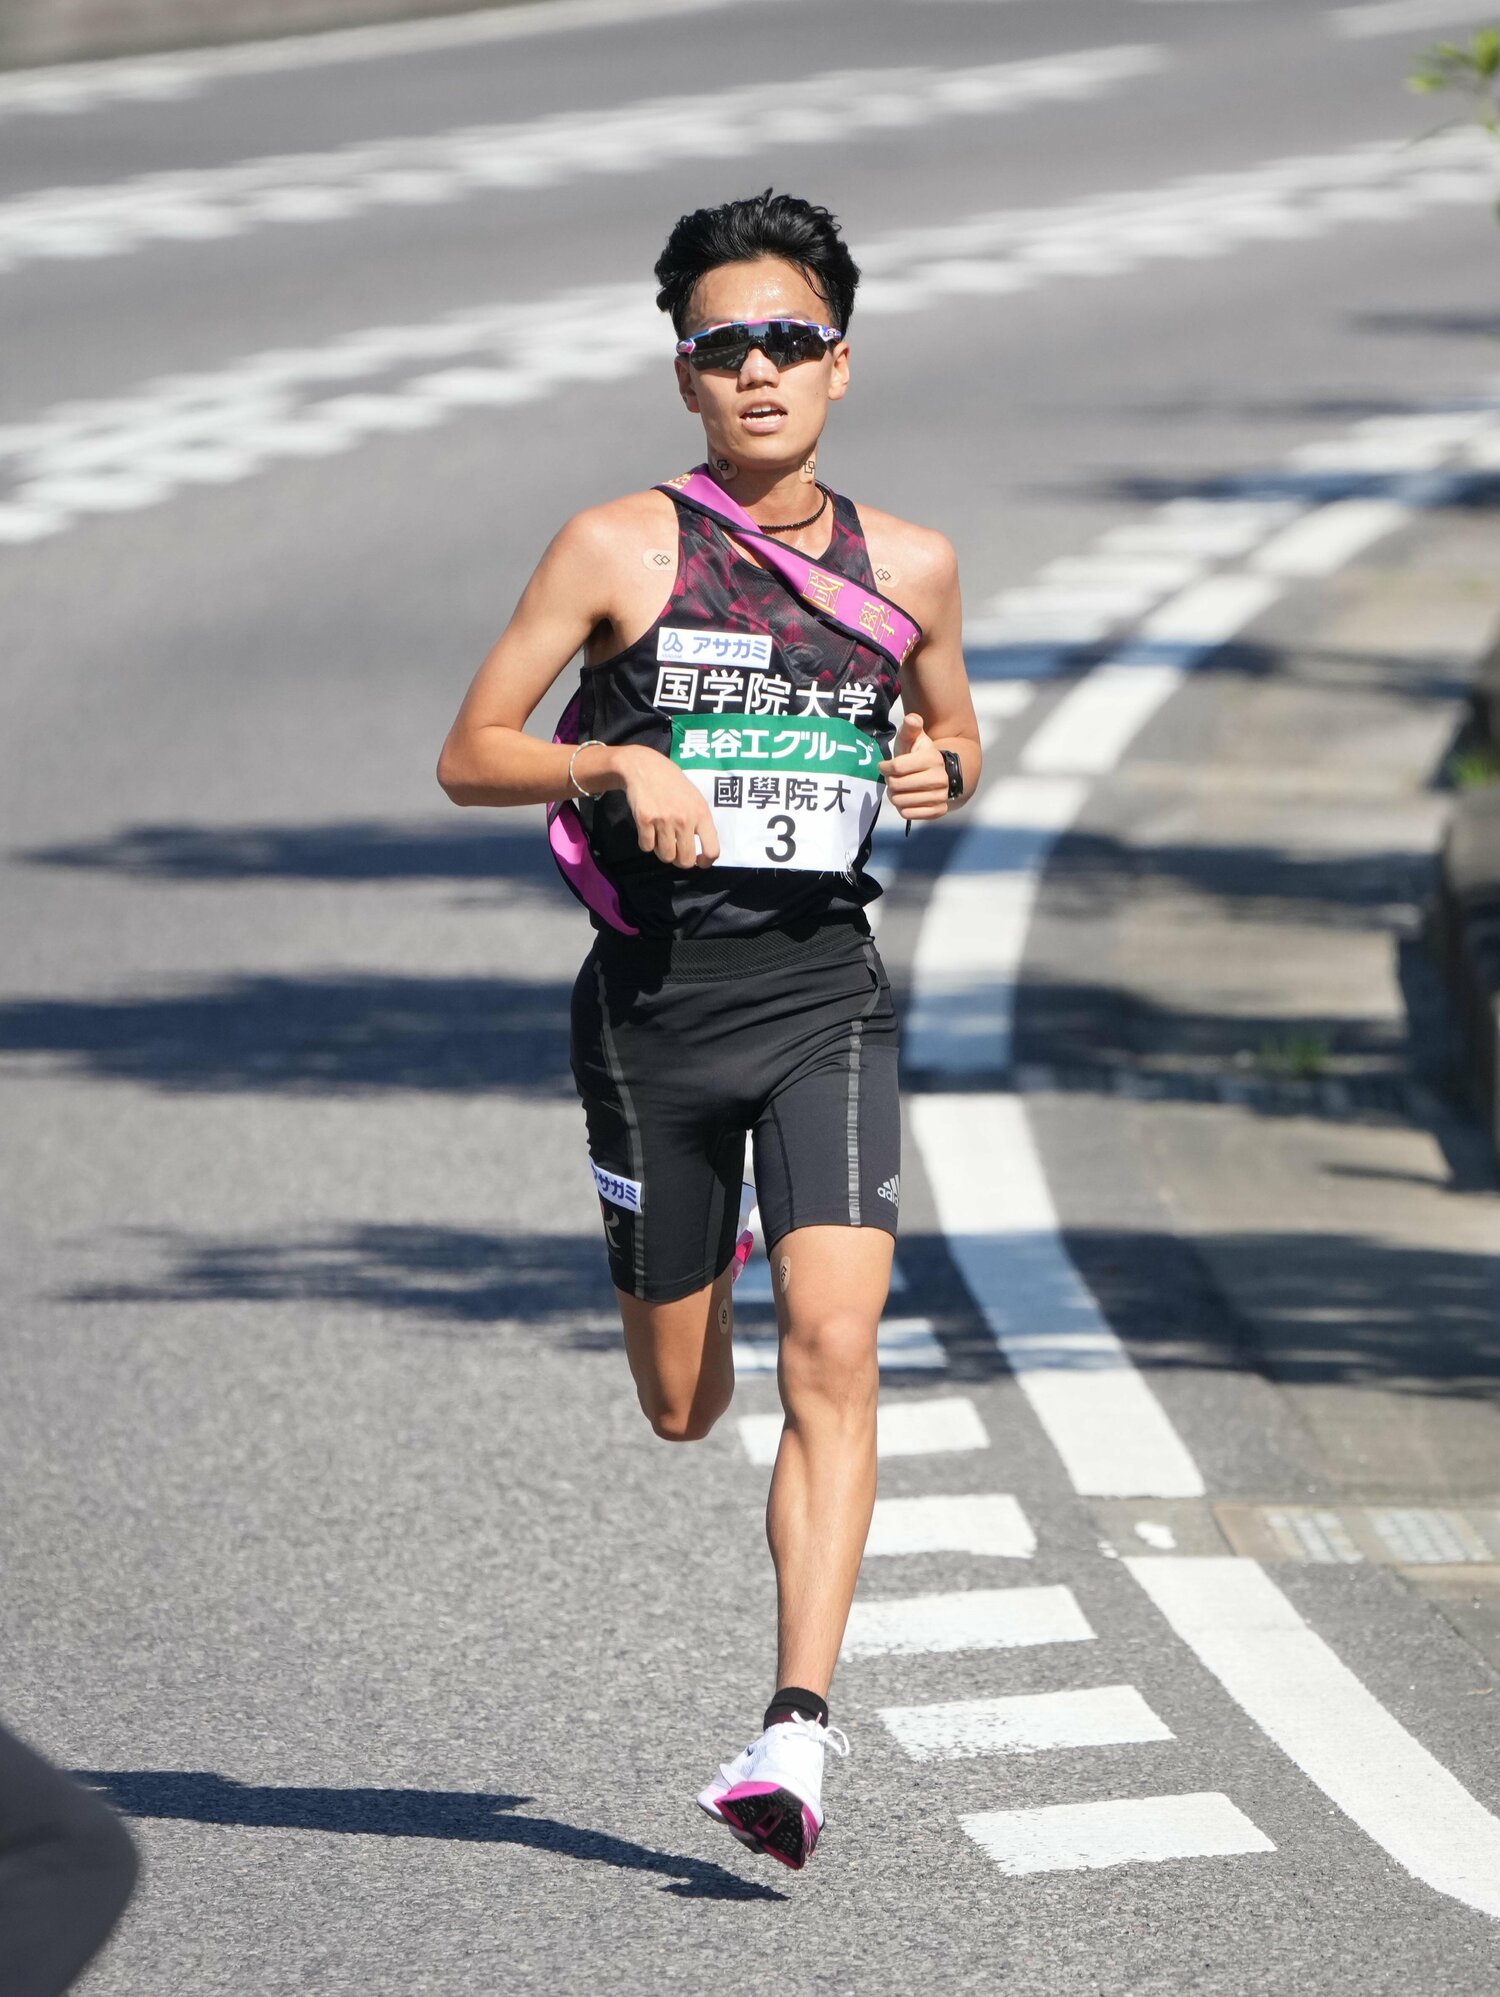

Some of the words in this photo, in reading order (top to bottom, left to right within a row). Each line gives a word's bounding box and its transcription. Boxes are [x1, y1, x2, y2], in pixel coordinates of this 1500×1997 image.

[692, 635, 768, 661] アサガミ
[653, 666, 877, 724] 国学院大学
[713, 775, 852, 814] 國學院大
[765, 814, 797, 863] 3
